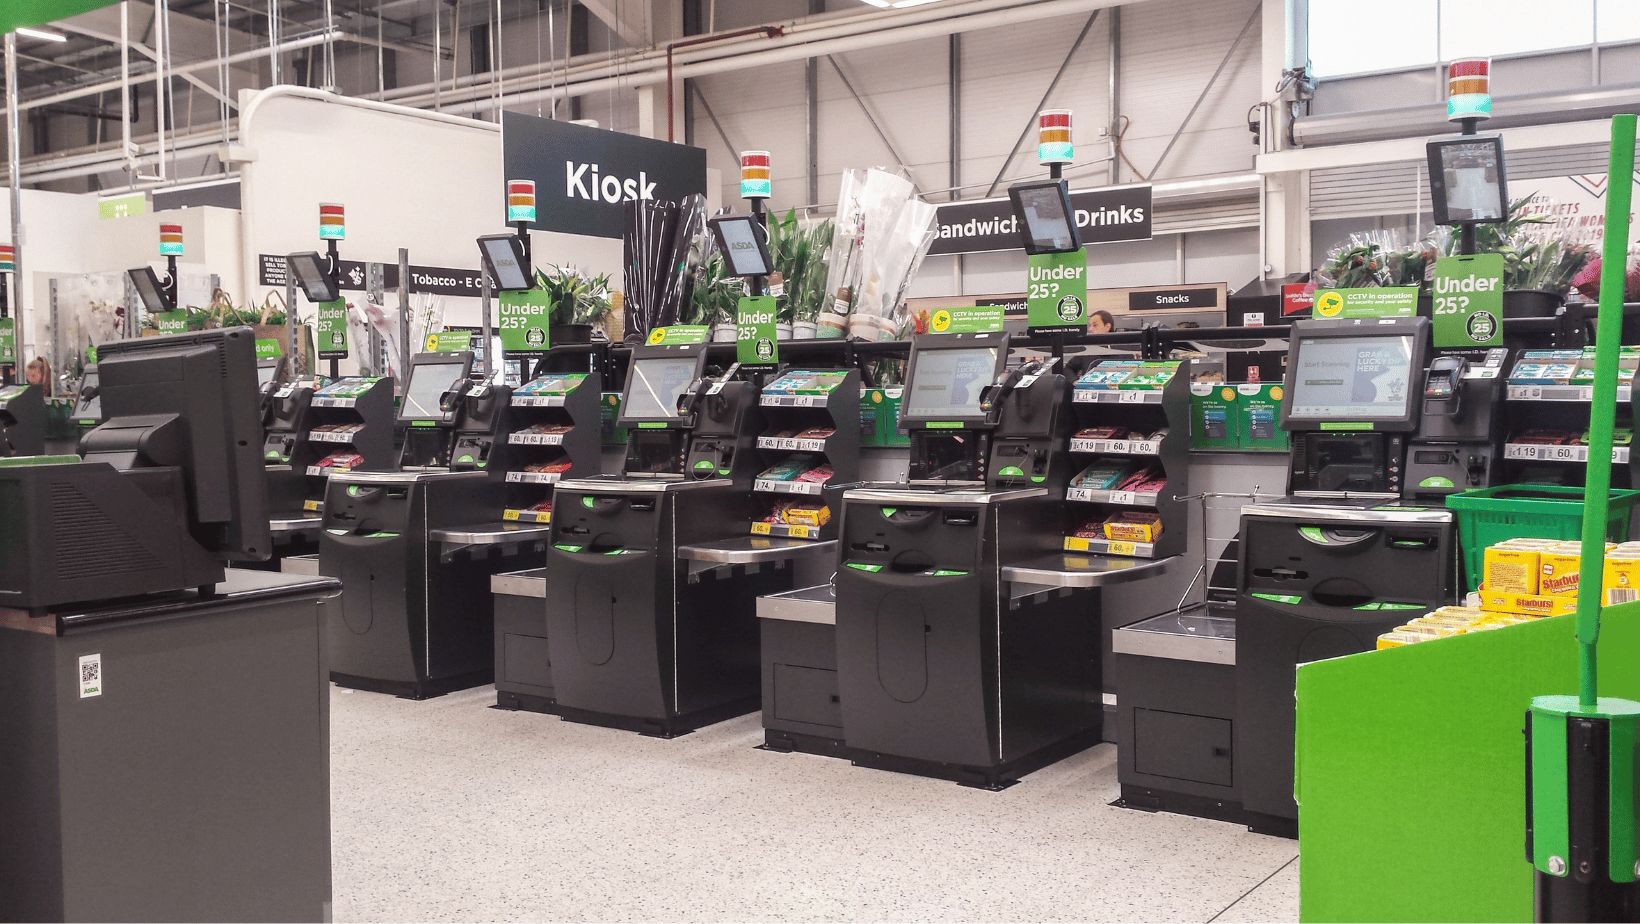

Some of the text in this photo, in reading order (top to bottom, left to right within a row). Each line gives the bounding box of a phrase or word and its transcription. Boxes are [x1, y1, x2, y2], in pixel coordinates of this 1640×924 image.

[566, 160, 658, 204] Kiosk
[1074, 204, 1145, 228] Drinks
[731, 241, 755, 250] ASDA
[1030, 264, 1084, 281] Under
[411, 273, 456, 287] Tobacco
[465, 277, 473, 288] E
[1436, 274, 1499, 293] Under
[1029, 283, 1060, 299] 25?
[1377, 292, 1413, 301] operation
[1155, 294, 1190, 304] Snacks
[1435, 296, 1470, 314] 25?
[319, 307, 345, 319] Under
[501, 303, 546, 315] Under
[974, 310, 1001, 318] operation
[1063, 306, 1077, 314] 25
[501, 317, 528, 329] 25?
[738, 310, 774, 325] Under
[158, 318, 186, 330] Under
[318, 320, 333, 332] 25?
[1474, 324, 1490, 333] 25
[738, 326, 758, 340] 25?
[760, 346, 770, 354] 25
[1304, 360, 1350, 369] Start Scanning
[1542, 573, 1580, 590] Starbu
[1516, 598, 1554, 609] Starburst
